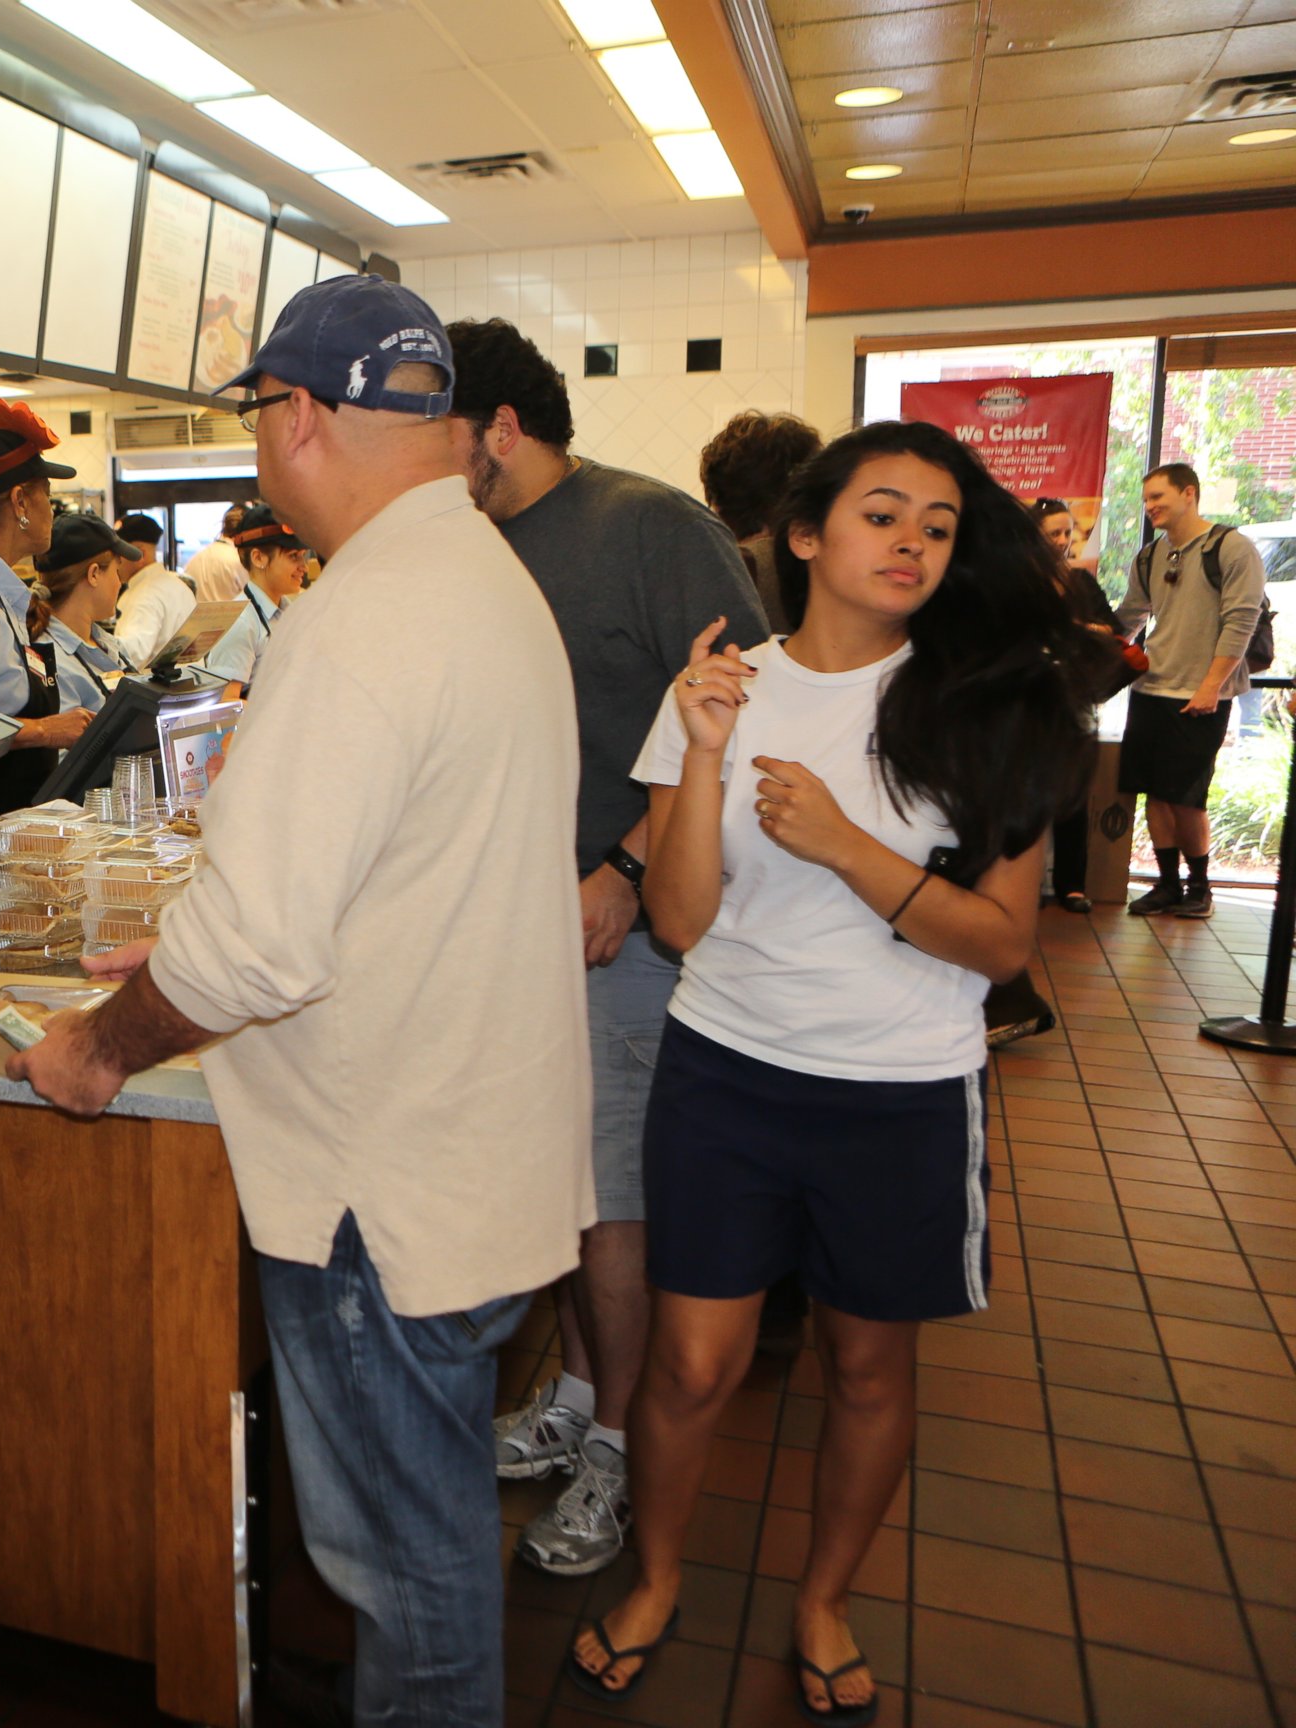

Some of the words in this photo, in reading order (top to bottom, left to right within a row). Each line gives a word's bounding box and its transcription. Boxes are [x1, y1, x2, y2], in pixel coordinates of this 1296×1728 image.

[954, 425, 984, 442] We
[988, 422, 1048, 442] Cater!
[1037, 444, 1067, 454] events
[994, 454, 1048, 466] celebrations
[1024, 464, 1056, 475] Parties
